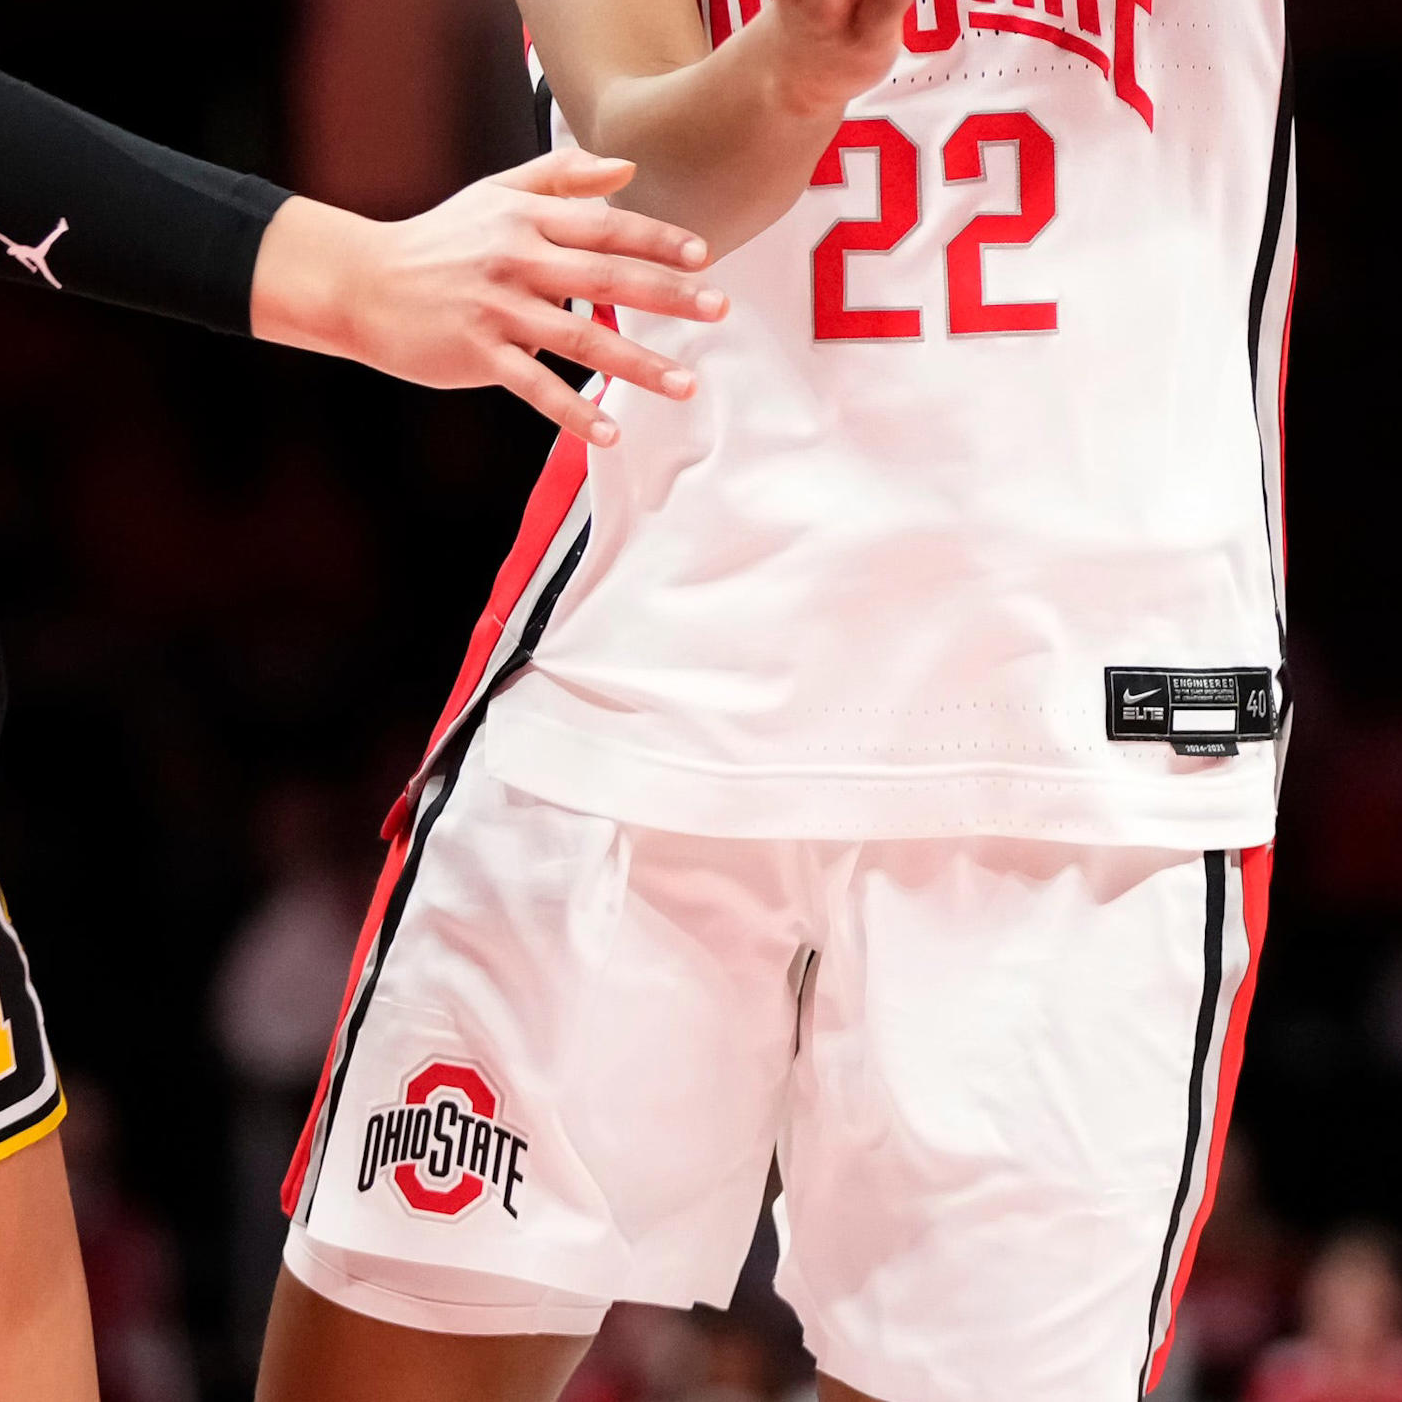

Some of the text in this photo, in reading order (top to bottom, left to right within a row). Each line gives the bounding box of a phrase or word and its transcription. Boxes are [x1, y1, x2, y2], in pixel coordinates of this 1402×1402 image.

[806, 109, 1060, 343] 22
[1173, 678, 1234, 688] ENGINEERED
[1246, 689, 1267, 718] 40
[1122, 706, 1165, 720] ELITE
[1185, 743, 1226, 753] 2024-2025
